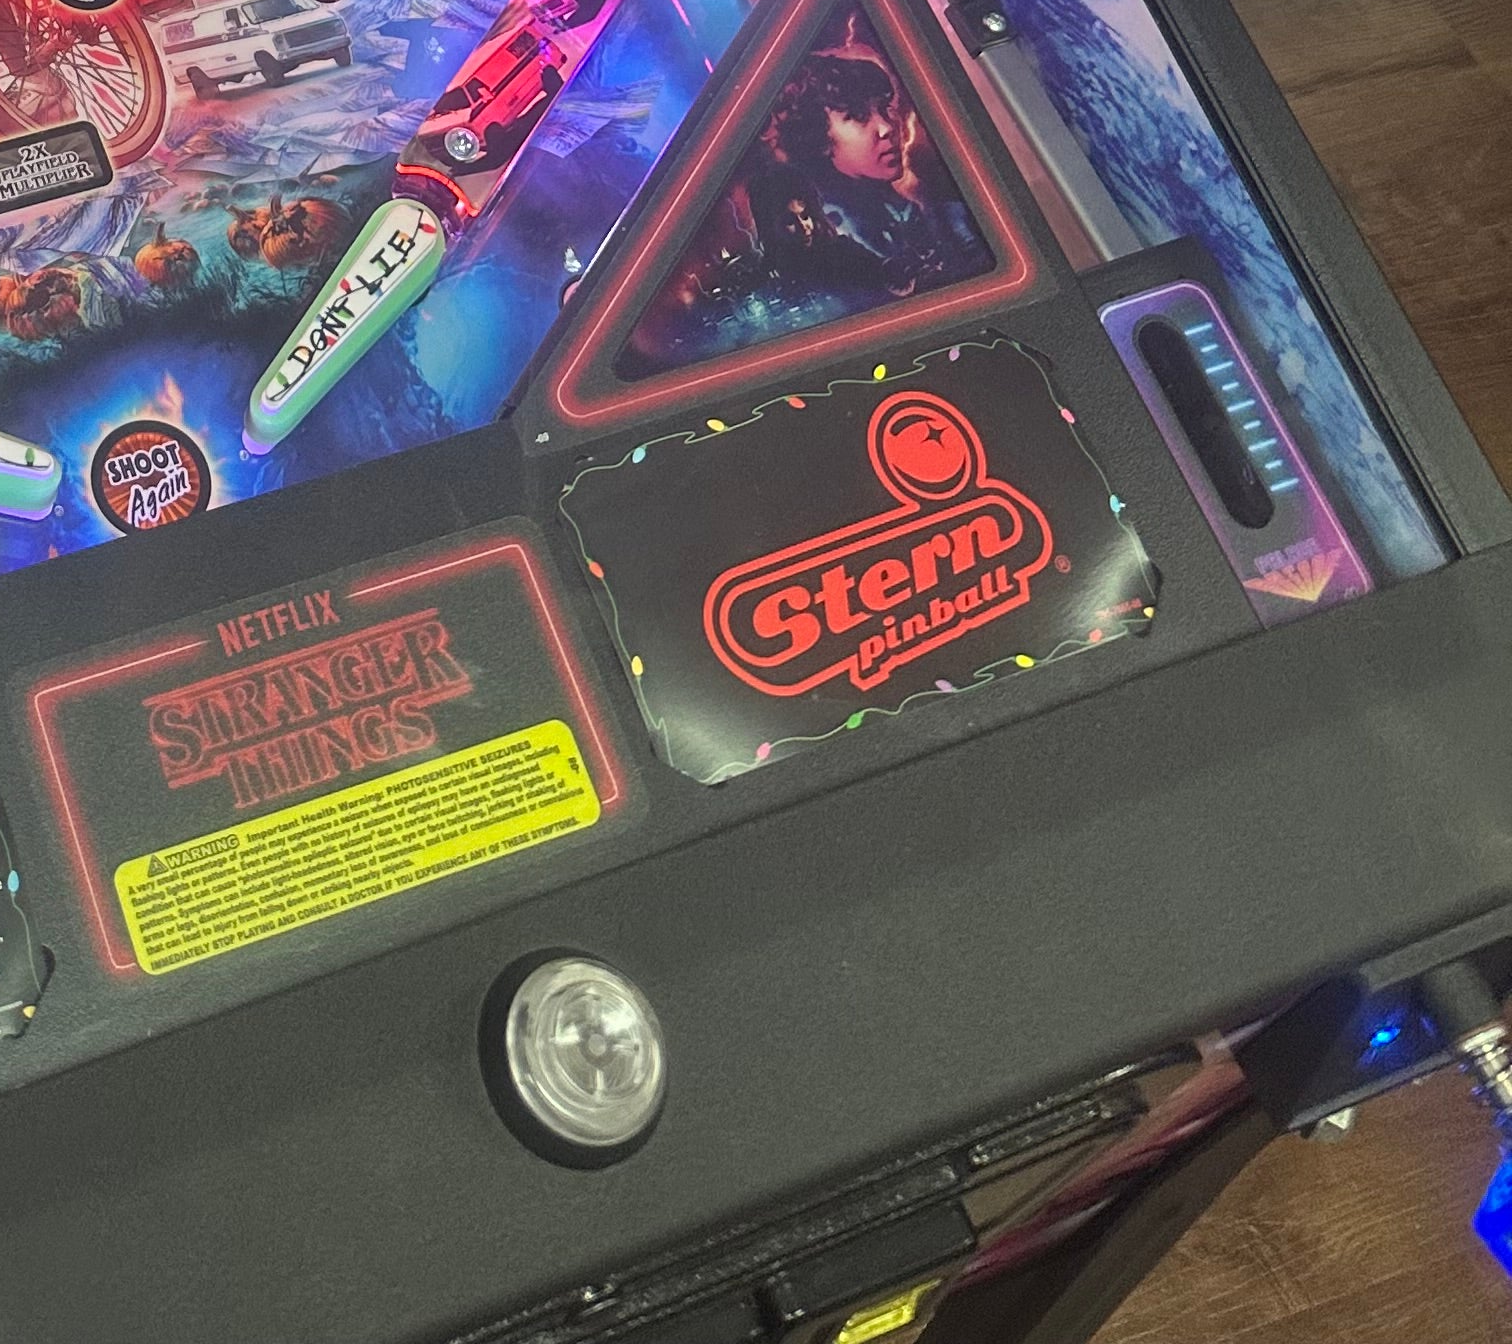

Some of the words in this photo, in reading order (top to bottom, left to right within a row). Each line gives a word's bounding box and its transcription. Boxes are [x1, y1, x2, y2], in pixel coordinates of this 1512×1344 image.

[0, 151, 78, 182] PLAYFIELD
[20, 142, 49, 162] 2X
[356, 229, 416, 296] LIE
[104, 440, 183, 484] SHOOT
[128, 468, 189, 526] Again
[751, 514, 1013, 650] Stern
[216, 590, 340, 656] NETFLIX
[859, 571, 1015, 670] pinball
[147, 620, 471, 774] STRANGER
[225, 698, 438, 809] THINGS
[246, 814, 300, 843] Important
[301, 801, 335, 825] Health
[338, 789, 385, 816] Warning:
[386, 757, 478, 796] PHOTOSENSITIVE
[480, 740, 532, 767] SEIZURES
[165, 834, 239, 869] WARNING
